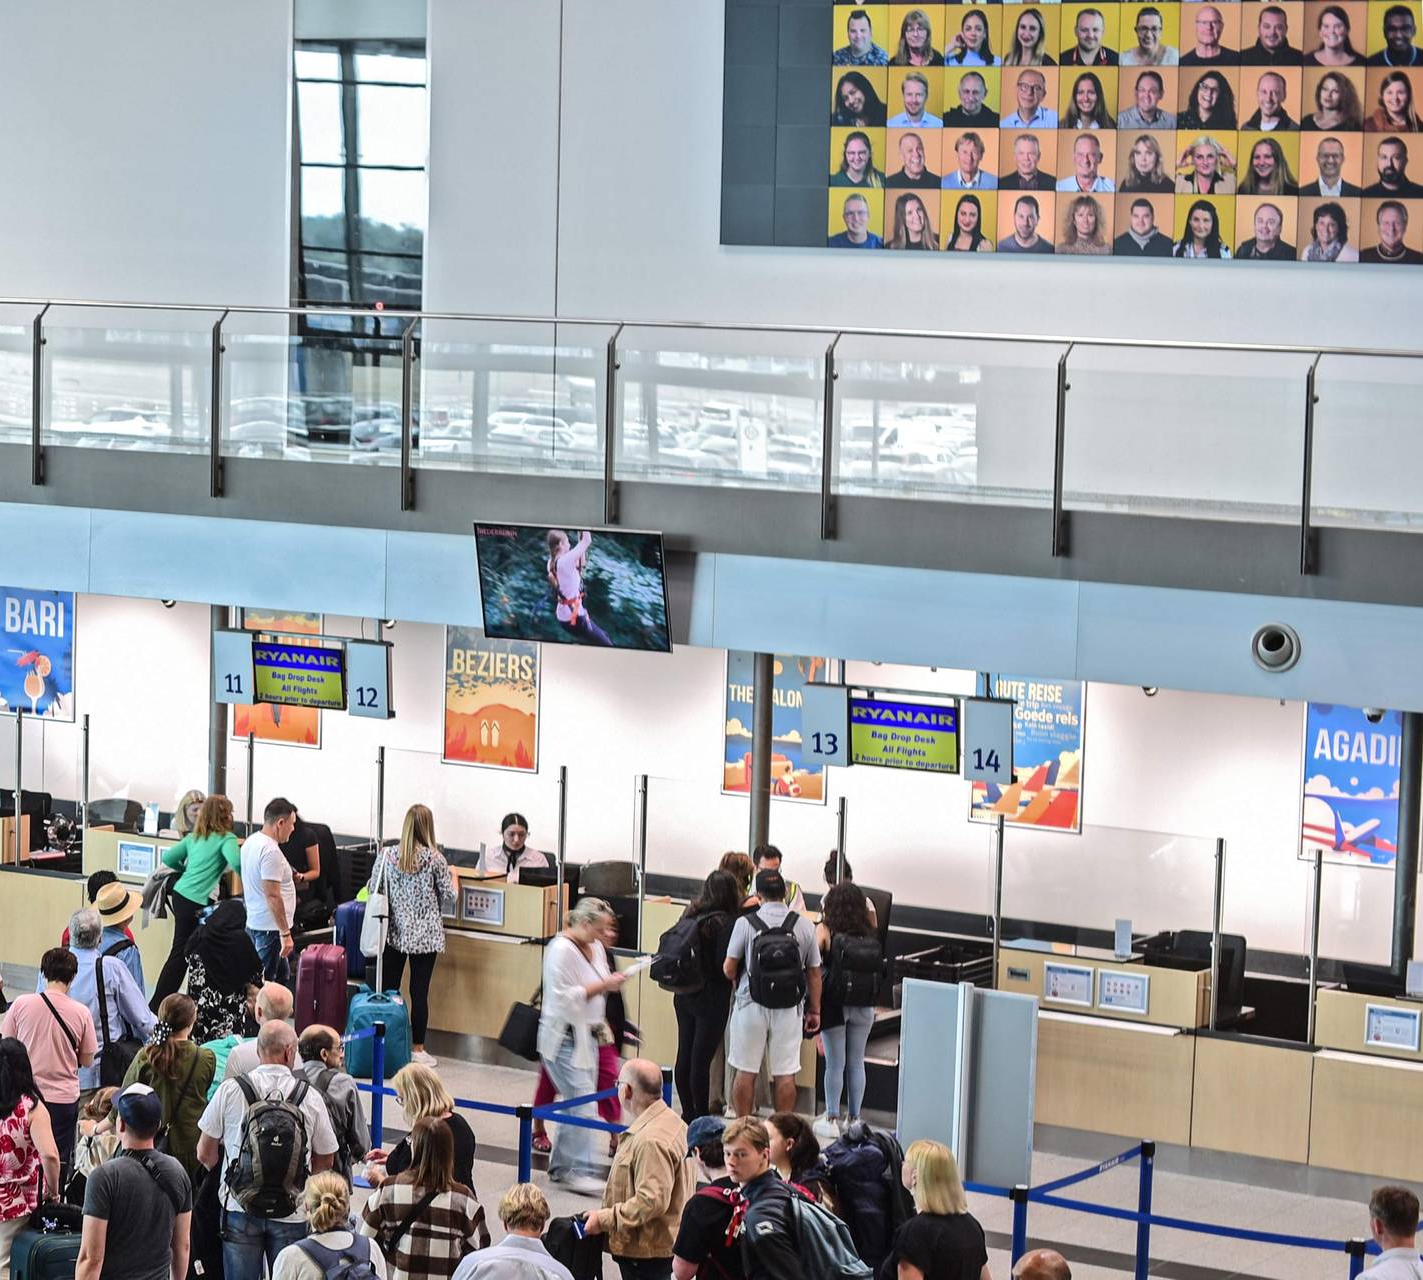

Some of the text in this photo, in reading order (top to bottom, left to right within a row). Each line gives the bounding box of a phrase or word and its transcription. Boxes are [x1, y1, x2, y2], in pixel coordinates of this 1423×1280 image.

[5, 597, 64, 638] BARI
[255, 649, 339, 668] RYANAIR
[452, 648, 534, 680] BEZIERS
[224, 673, 244, 695] 11
[271, 671, 325, 684] Bag Drop Desk
[281, 684, 318, 695] All Flights
[356, 686, 379, 708] 12
[995, 679, 1063, 704] GUTE REISE
[308, 697, 341, 706] departure
[852, 706, 954, 727] RYANAIR
[1014, 706, 1079, 727] Goede reis
[811, 731, 839, 755] 13
[871, 730, 936, 745] Bag Drop Desk
[1313, 728, 1402, 767] AGADI
[861, 753, 883, 763] hours
[884, 756, 903, 766] prior
[905, 758, 914, 767] to
[915, 759, 955, 770] departure
[882, 745, 927, 757] All Flights
[972, 748, 1001, 773] 14
